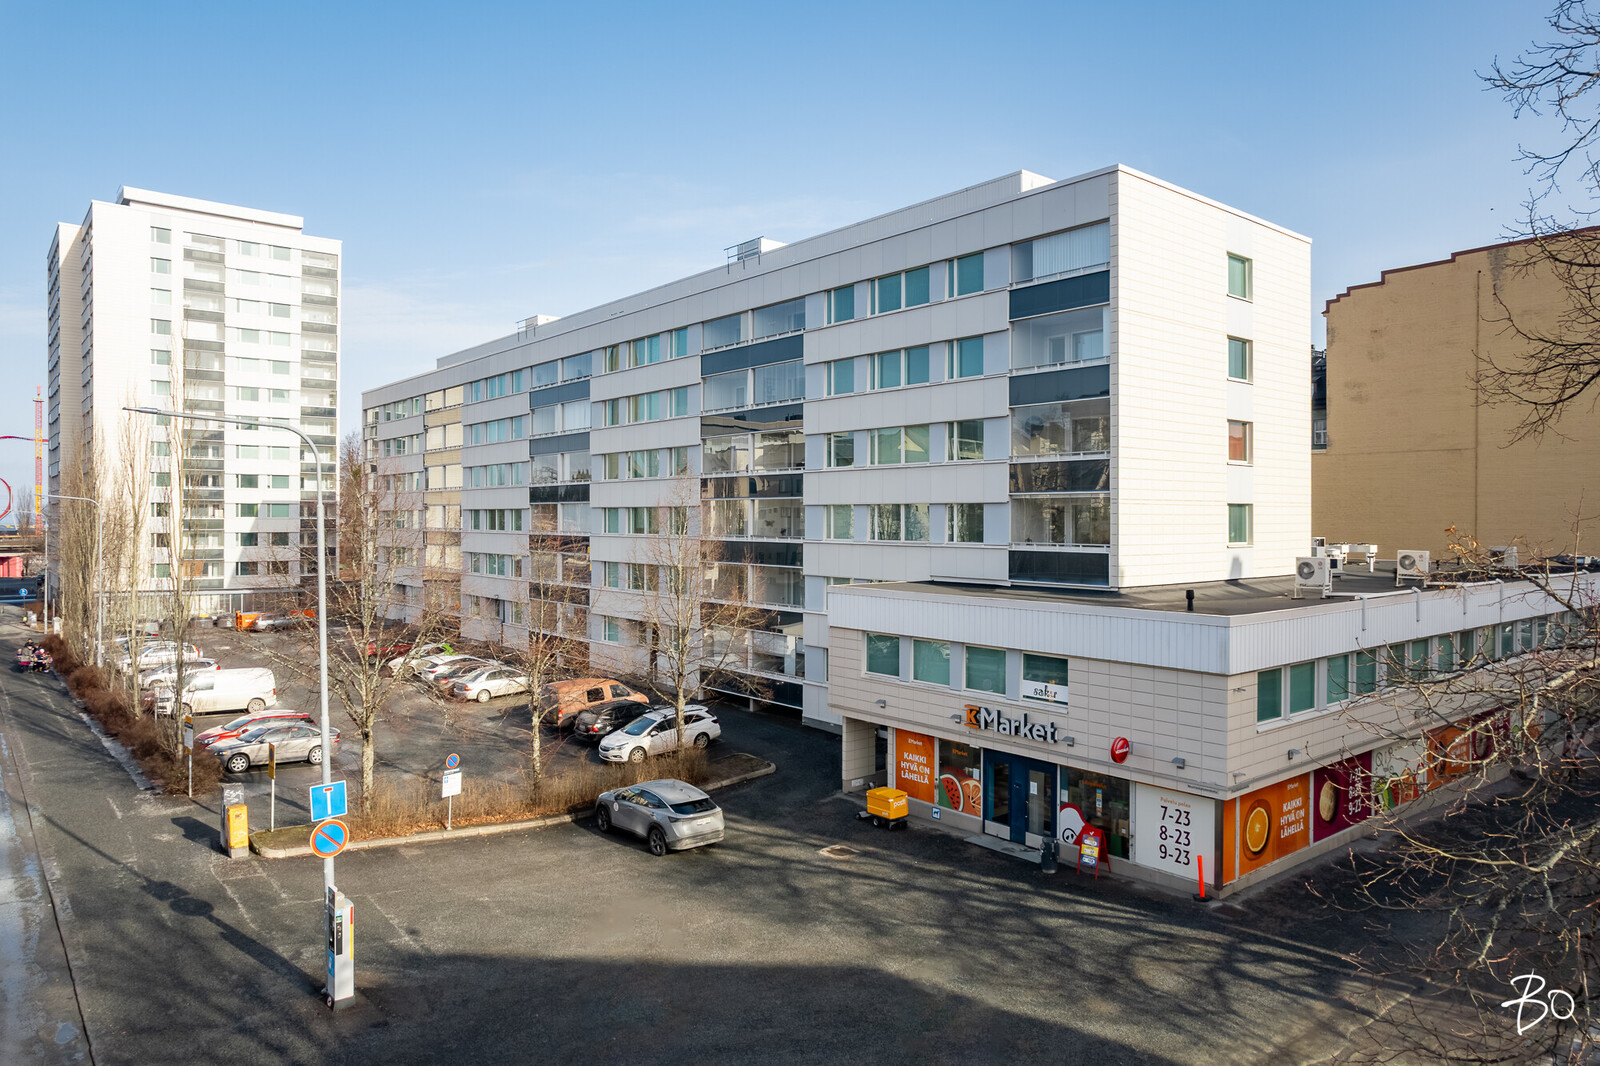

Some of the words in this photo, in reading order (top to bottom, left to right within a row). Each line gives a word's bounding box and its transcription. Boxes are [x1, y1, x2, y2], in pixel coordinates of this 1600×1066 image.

[903, 752, 927, 764] KAIKKI
[901, 761, 918, 772] HYVÄ
[919, 765, 930, 775] ON
[901, 770, 929, 784] LÄHELLÄ
[1283, 797, 1302, 812] KAIKKI
[1160, 805, 1191, 826] 7-23
[1280, 810, 1295, 826] HYVÄ
[1159, 825, 1191, 847] 8-23
[1281, 819, 1304, 839] LÄHELLÄ
[1159, 844, 1190, 866] 9-23
